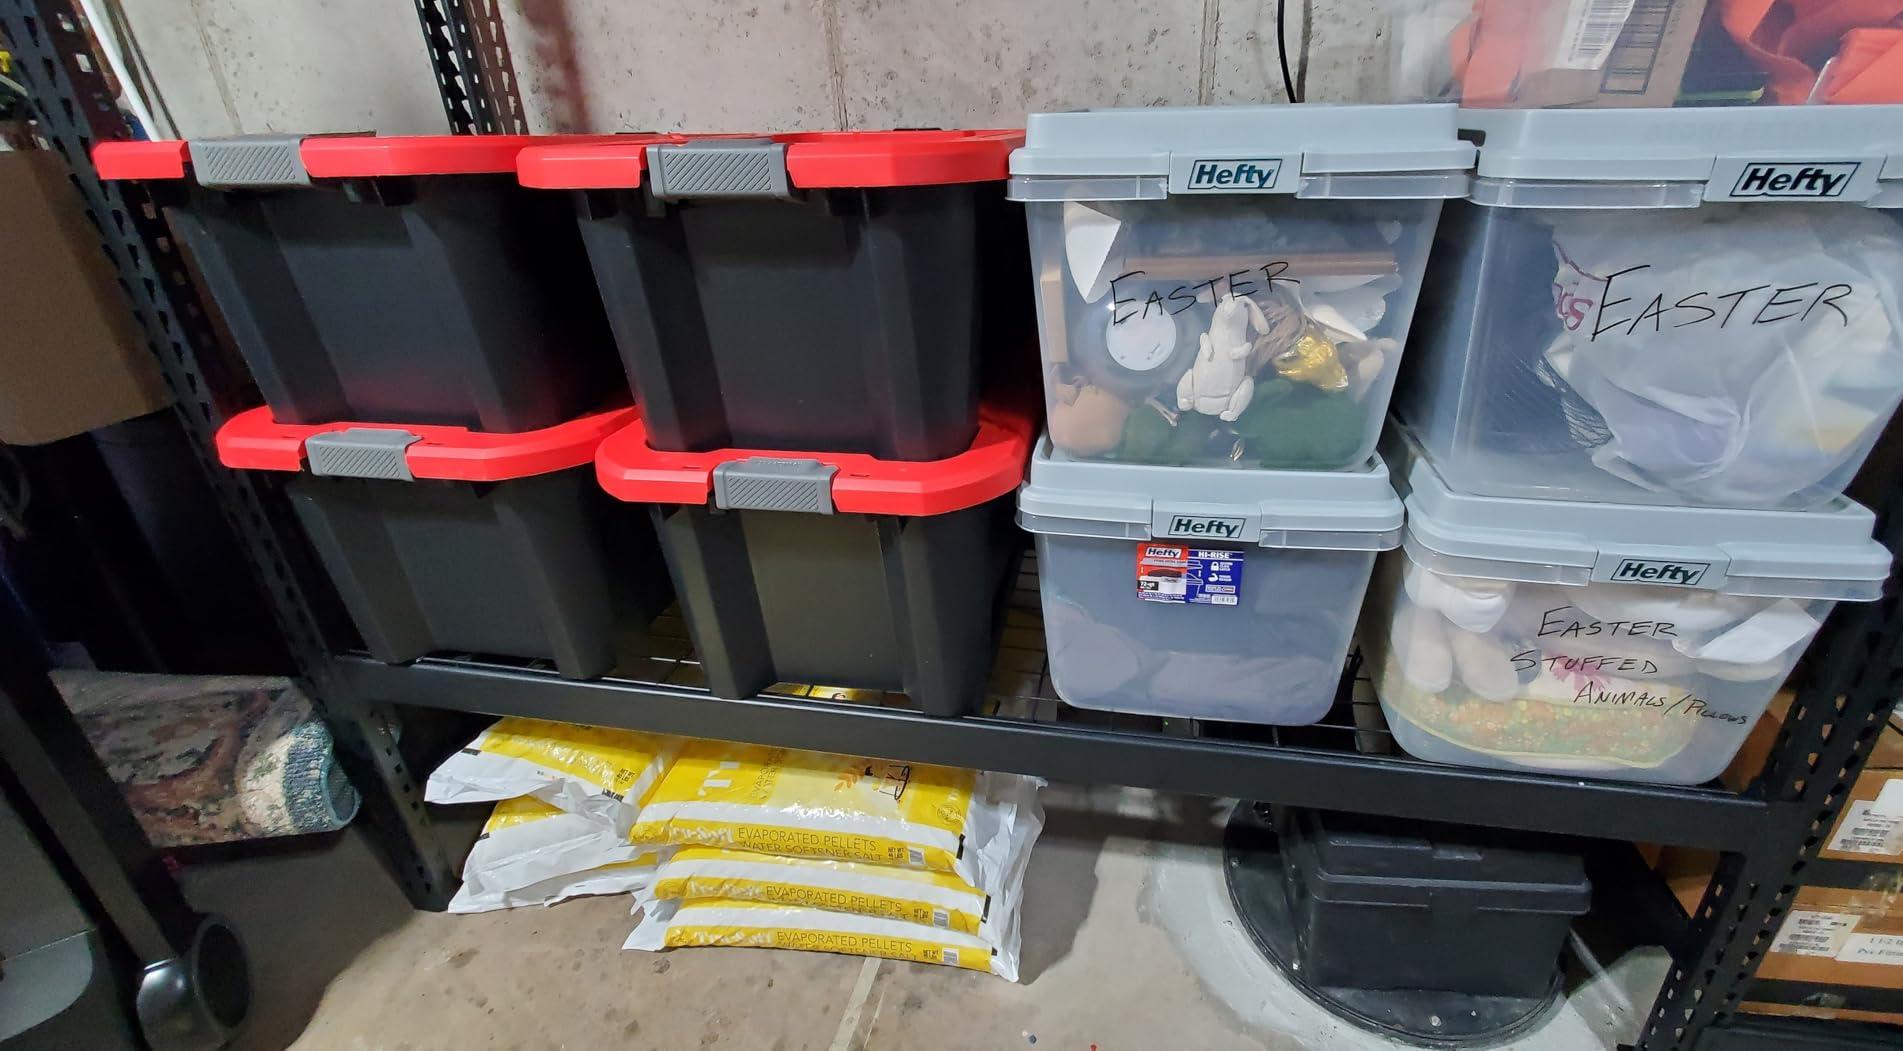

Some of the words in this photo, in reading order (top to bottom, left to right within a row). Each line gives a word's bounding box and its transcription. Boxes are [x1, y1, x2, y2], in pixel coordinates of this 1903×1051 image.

[1195, 163, 1275, 189] Hefty
[1741, 166, 1846, 197] Hefty
[1109, 261, 1301, 327] EASTER
[1591, 264, 1853, 342] EASTER
[1173, 517, 1240, 538] Hefty
[1147, 548, 1179, 558] Hefty
[1620, 562, 1702, 585] Hefty
[1537, 605, 1680, 638] EASTER
[1510, 649, 1659, 674] STUFFED
[738, 826, 820, 845] EVAPORATED
[824, 834, 877, 851] PELLETS
[766, 885, 847, 905] EVAPORATED
[851, 895, 902, 912] PELLETS
[777, 931, 858, 947] EVAPORATED
[861, 937, 913, 953] PELLETS
